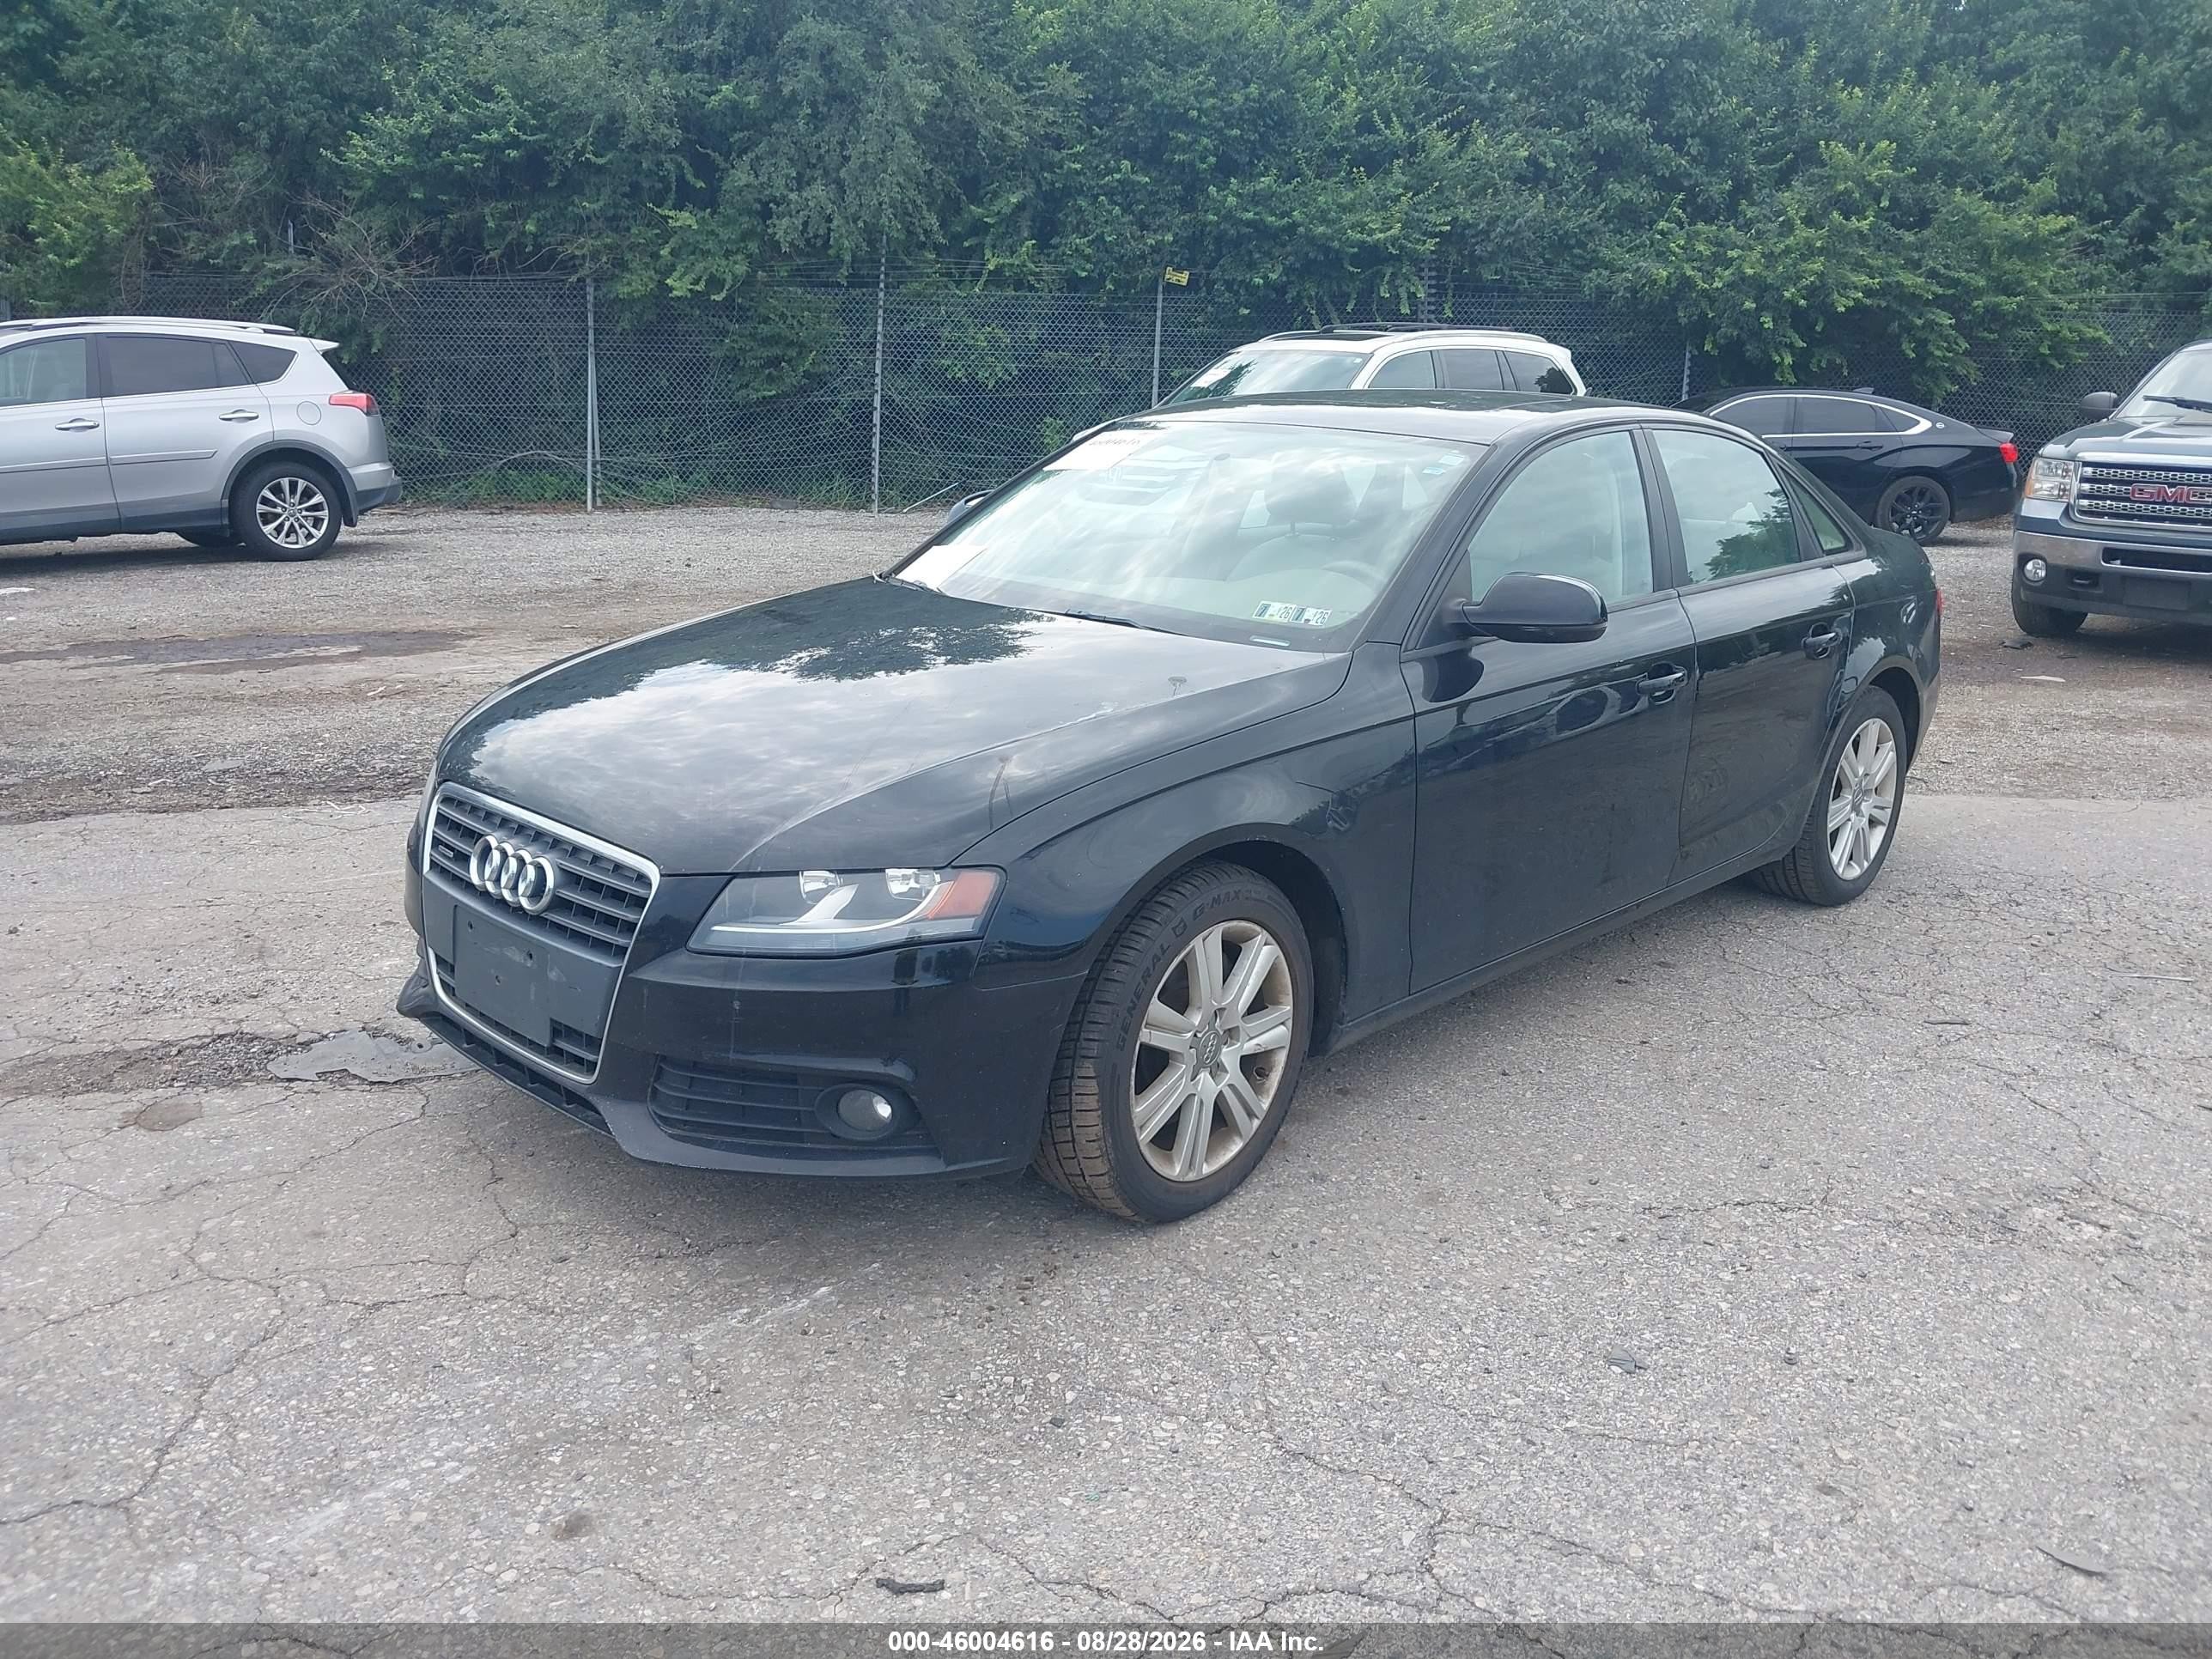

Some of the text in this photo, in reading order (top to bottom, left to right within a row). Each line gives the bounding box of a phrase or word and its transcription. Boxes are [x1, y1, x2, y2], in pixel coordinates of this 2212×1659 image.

[2130, 483, 2212, 504] GMC
[1279, 605, 1293, 619] 26
[1118, 943, 1170, 1052] GENERAL
